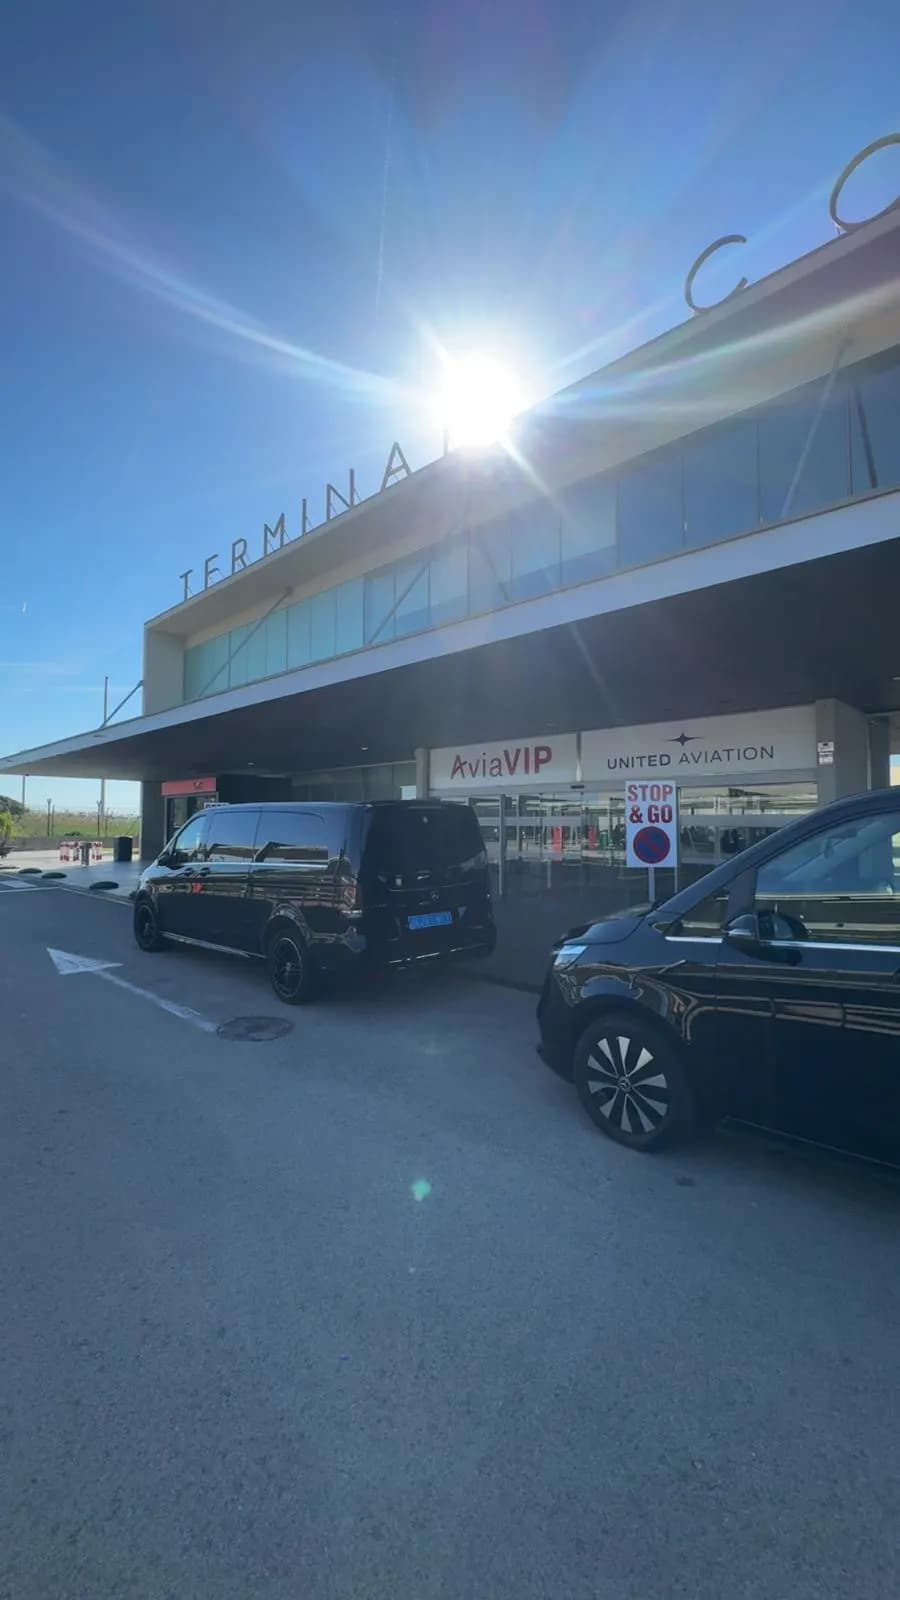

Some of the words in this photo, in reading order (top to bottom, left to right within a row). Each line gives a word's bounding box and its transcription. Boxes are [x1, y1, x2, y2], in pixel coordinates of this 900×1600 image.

[450, 745, 553, 780] AviaVIP
[607, 753, 672, 770] UNITED
[678, 745, 774, 765] AVIATION
[627, 783, 674, 802] STOP
[629, 804, 643, 824] &
[647, 804, 673, 824] GO
